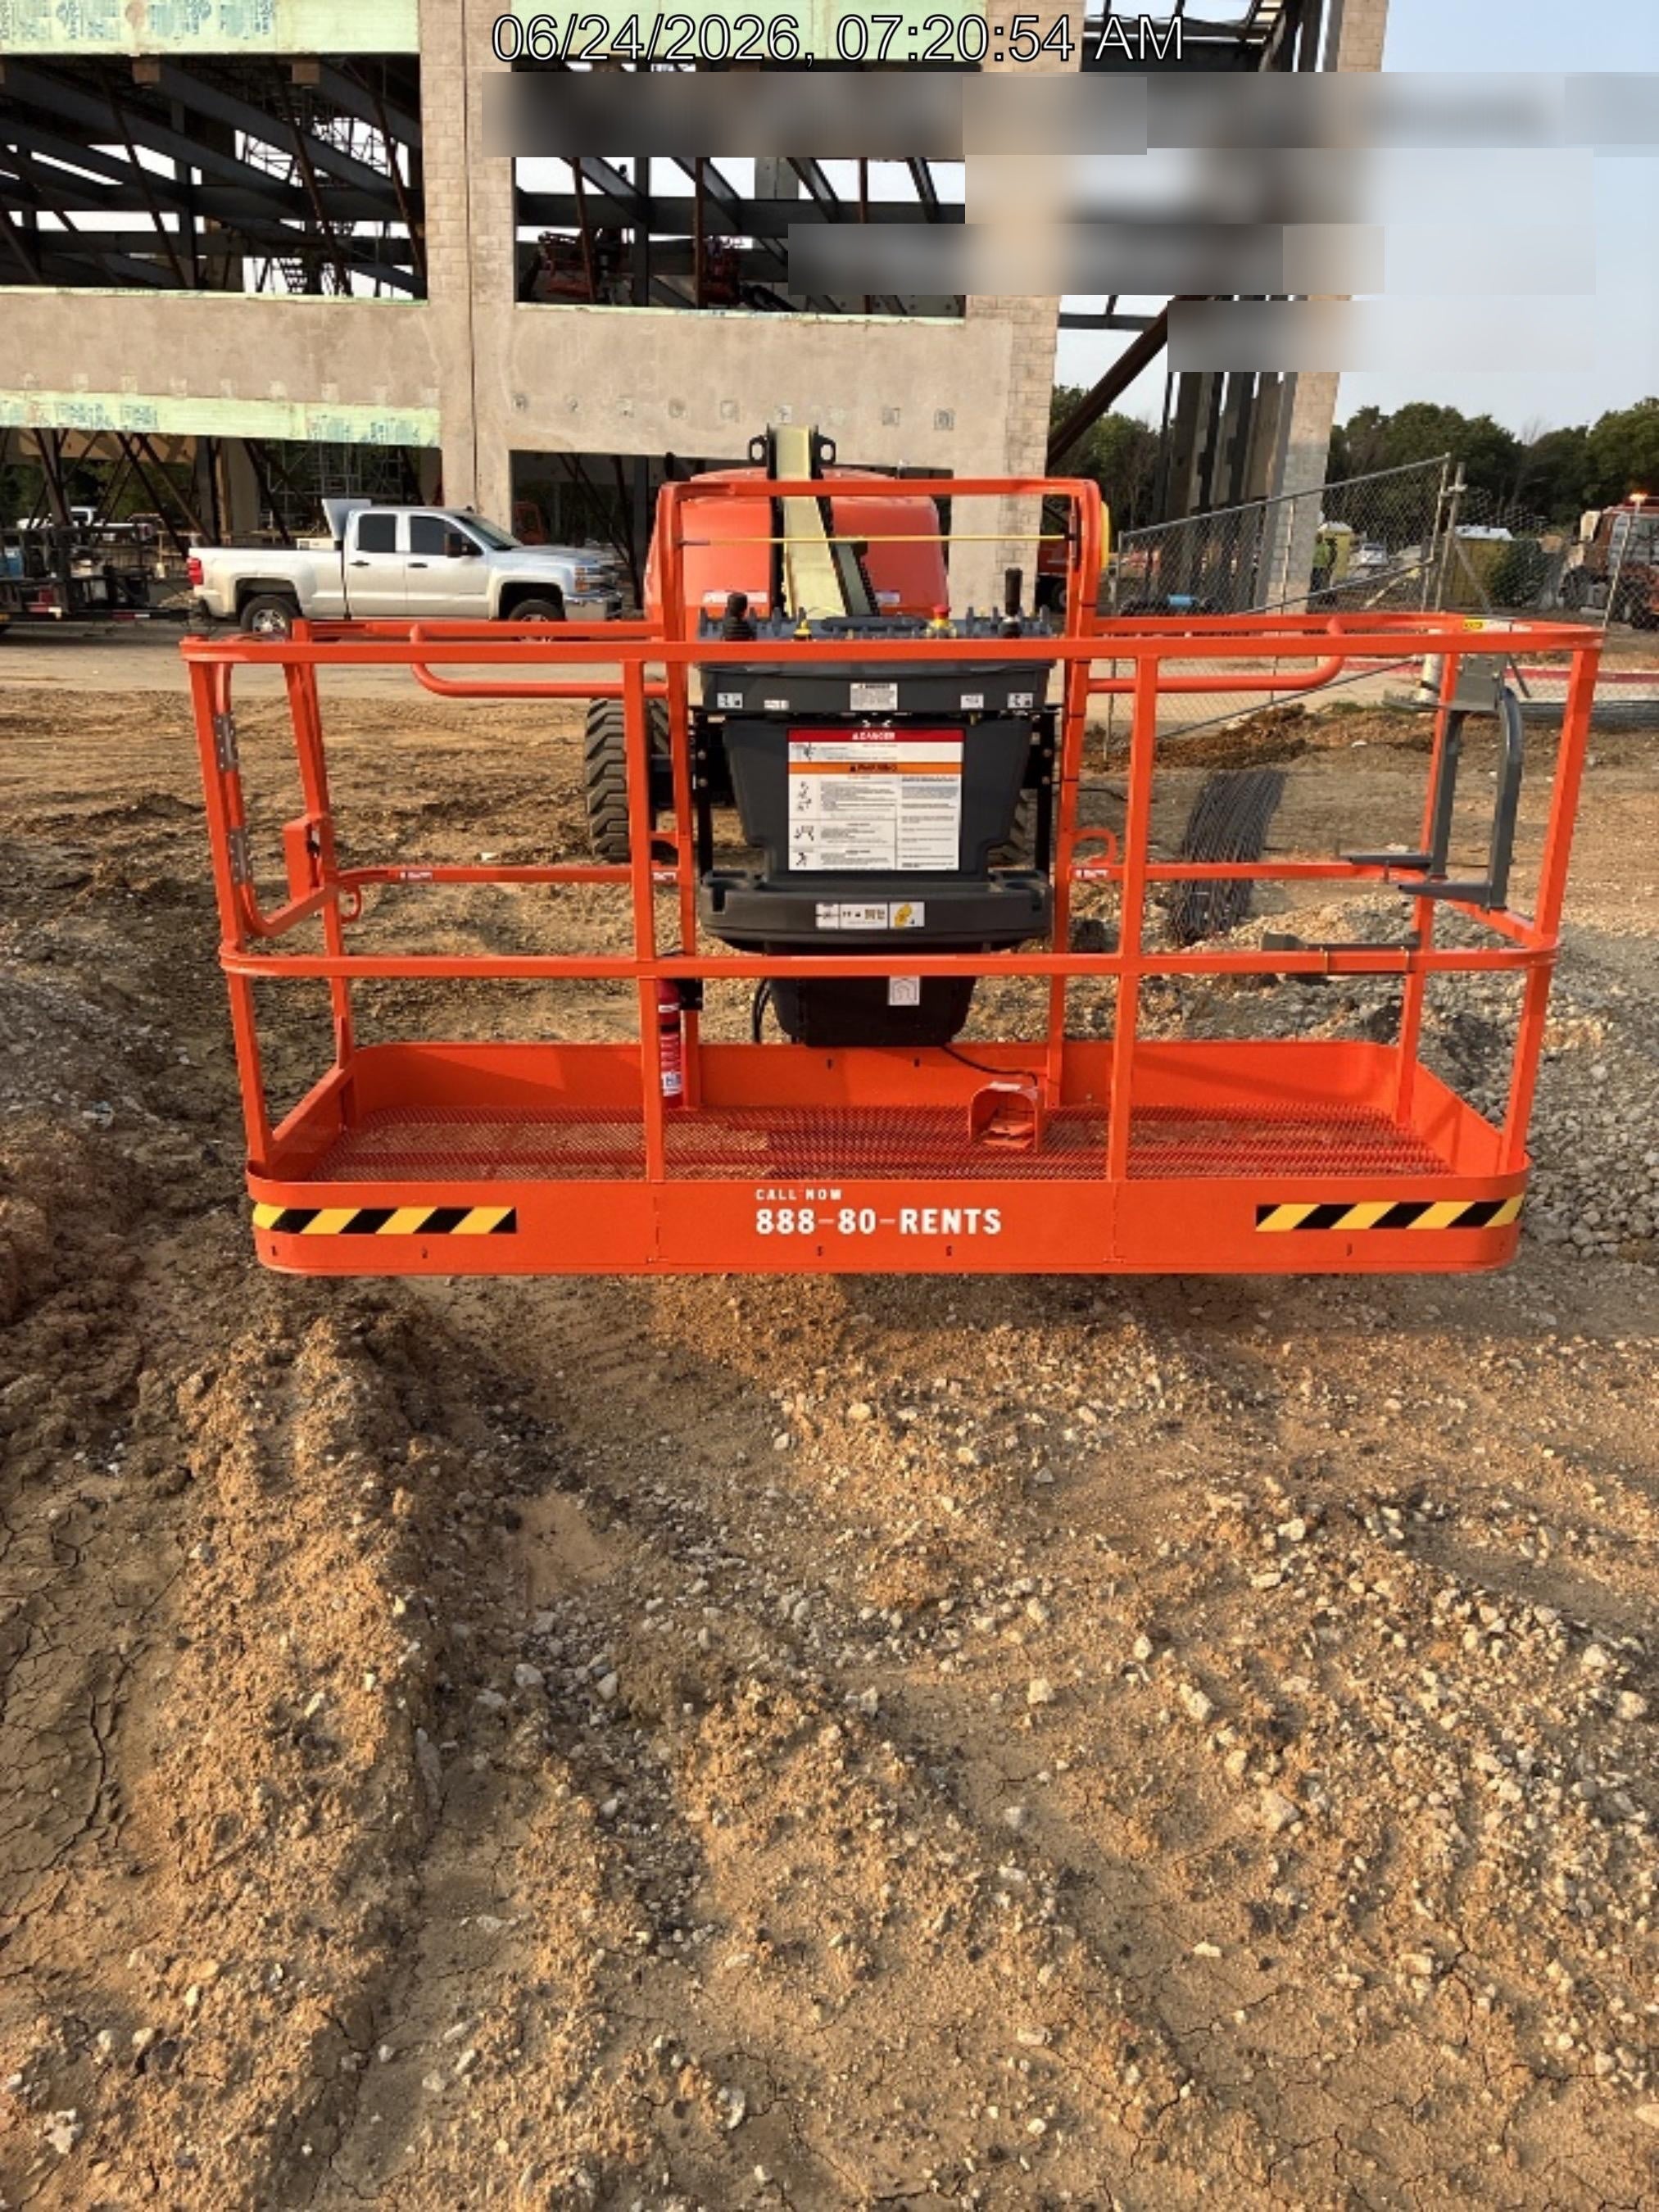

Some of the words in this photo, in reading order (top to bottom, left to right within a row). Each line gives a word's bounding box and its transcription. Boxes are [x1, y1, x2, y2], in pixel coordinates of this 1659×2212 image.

[755, 1189, 797, 1200] CALL
[805, 1189, 842, 1200] NOW
[756, 1208, 1001, 1235] 888-80-RENTS
